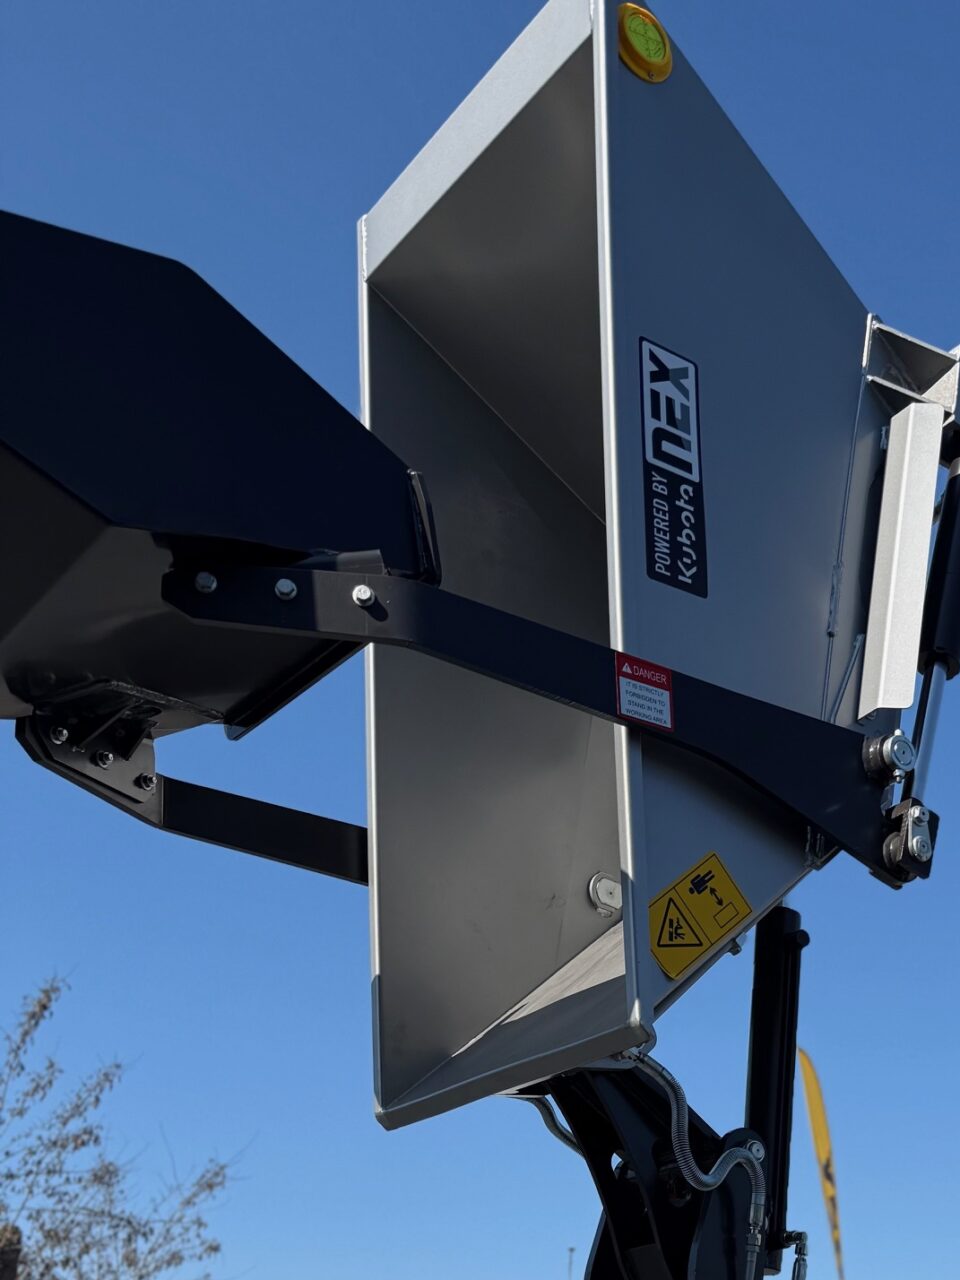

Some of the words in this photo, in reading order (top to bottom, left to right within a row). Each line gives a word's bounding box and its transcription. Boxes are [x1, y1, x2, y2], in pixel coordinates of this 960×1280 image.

[651, 471, 668, 496] BY
[653, 501, 671, 577] POWERED
[676, 484, 698, 584] Kubota
[633, 665, 667, 685] DANGER
